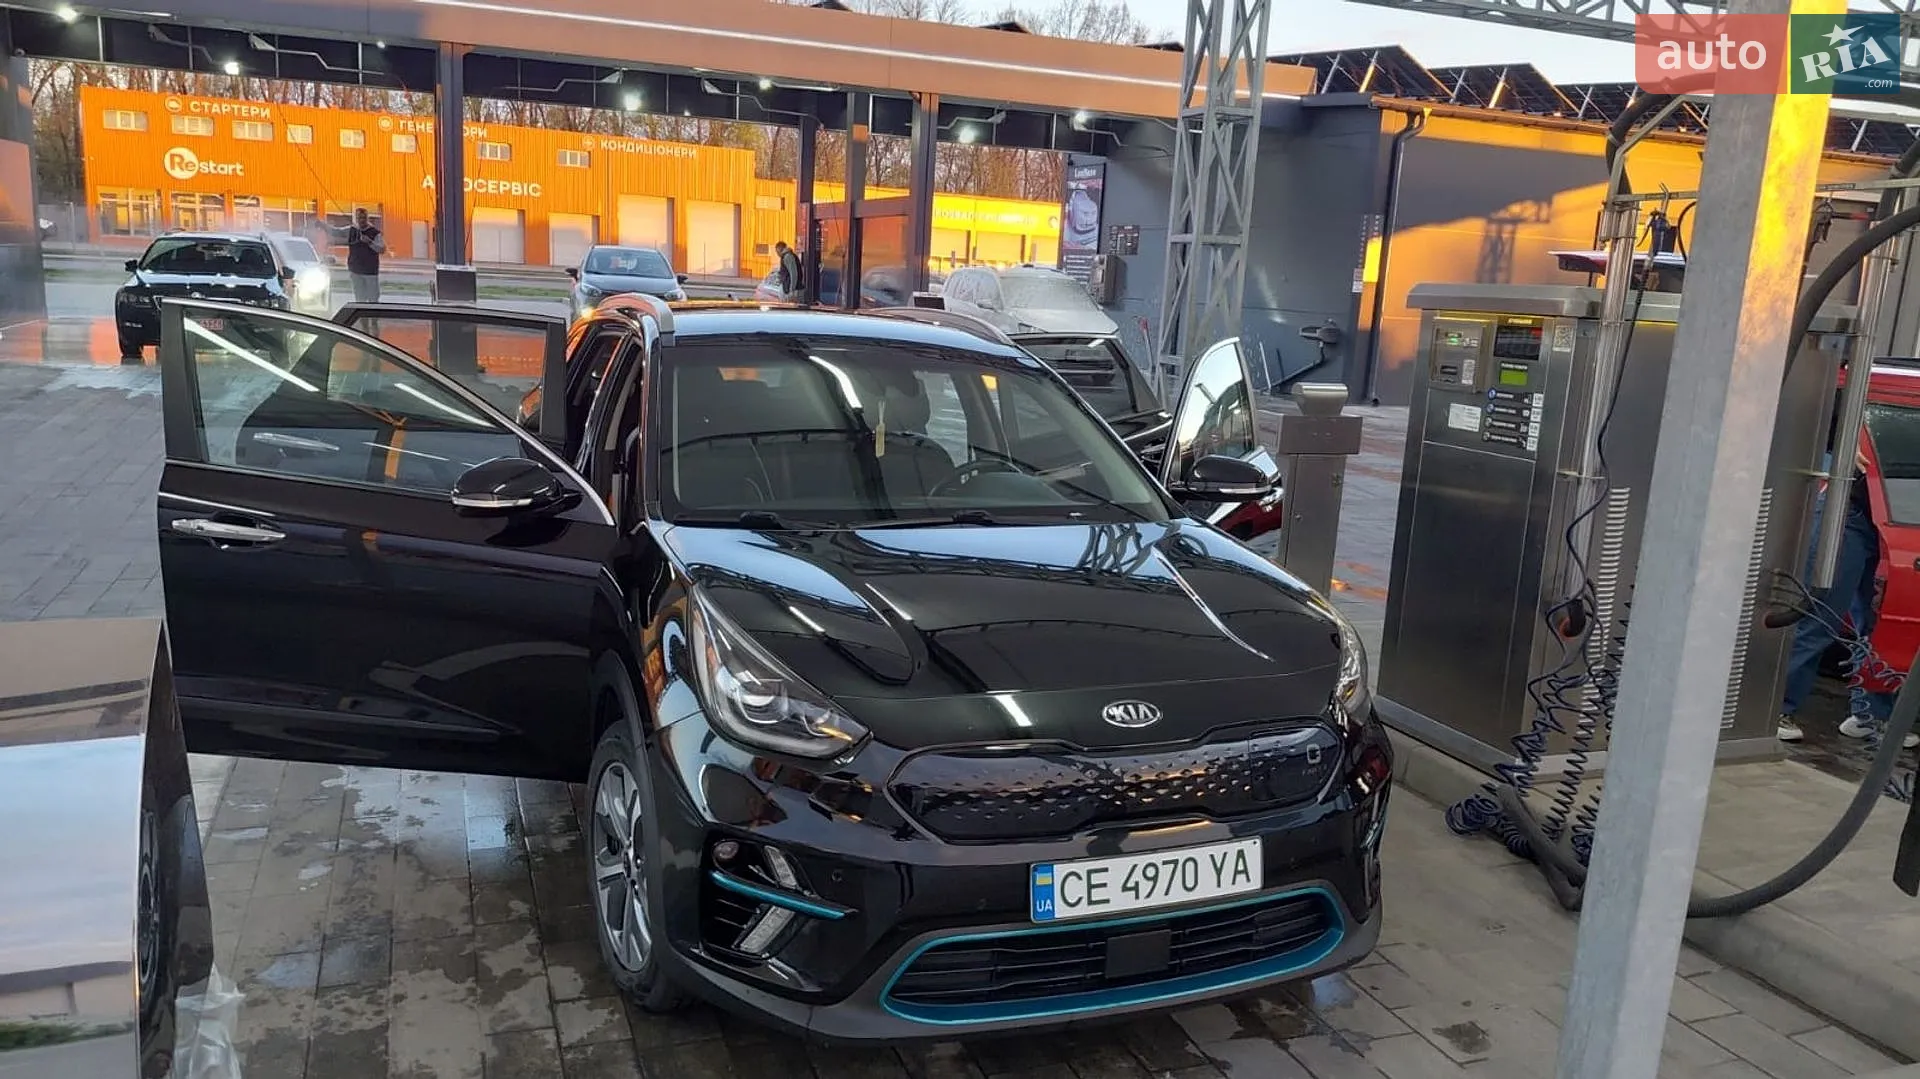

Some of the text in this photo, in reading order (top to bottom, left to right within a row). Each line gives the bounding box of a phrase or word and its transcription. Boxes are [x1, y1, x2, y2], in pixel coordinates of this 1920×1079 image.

[189, 100, 271, 119] СТАРТЕРИ
[399, 120, 488, 138] ГЕНЕОРИ
[600, 138, 698, 159] КОНДИЦІОНЕРИ
[168, 151, 245, 177] Restart
[422, 174, 542, 197] АОСЕРВІС
[1108, 703, 1152, 723] KIA
[1060, 848, 1251, 908] CE 4970 YA
[1035, 899, 1052, 913] UA
